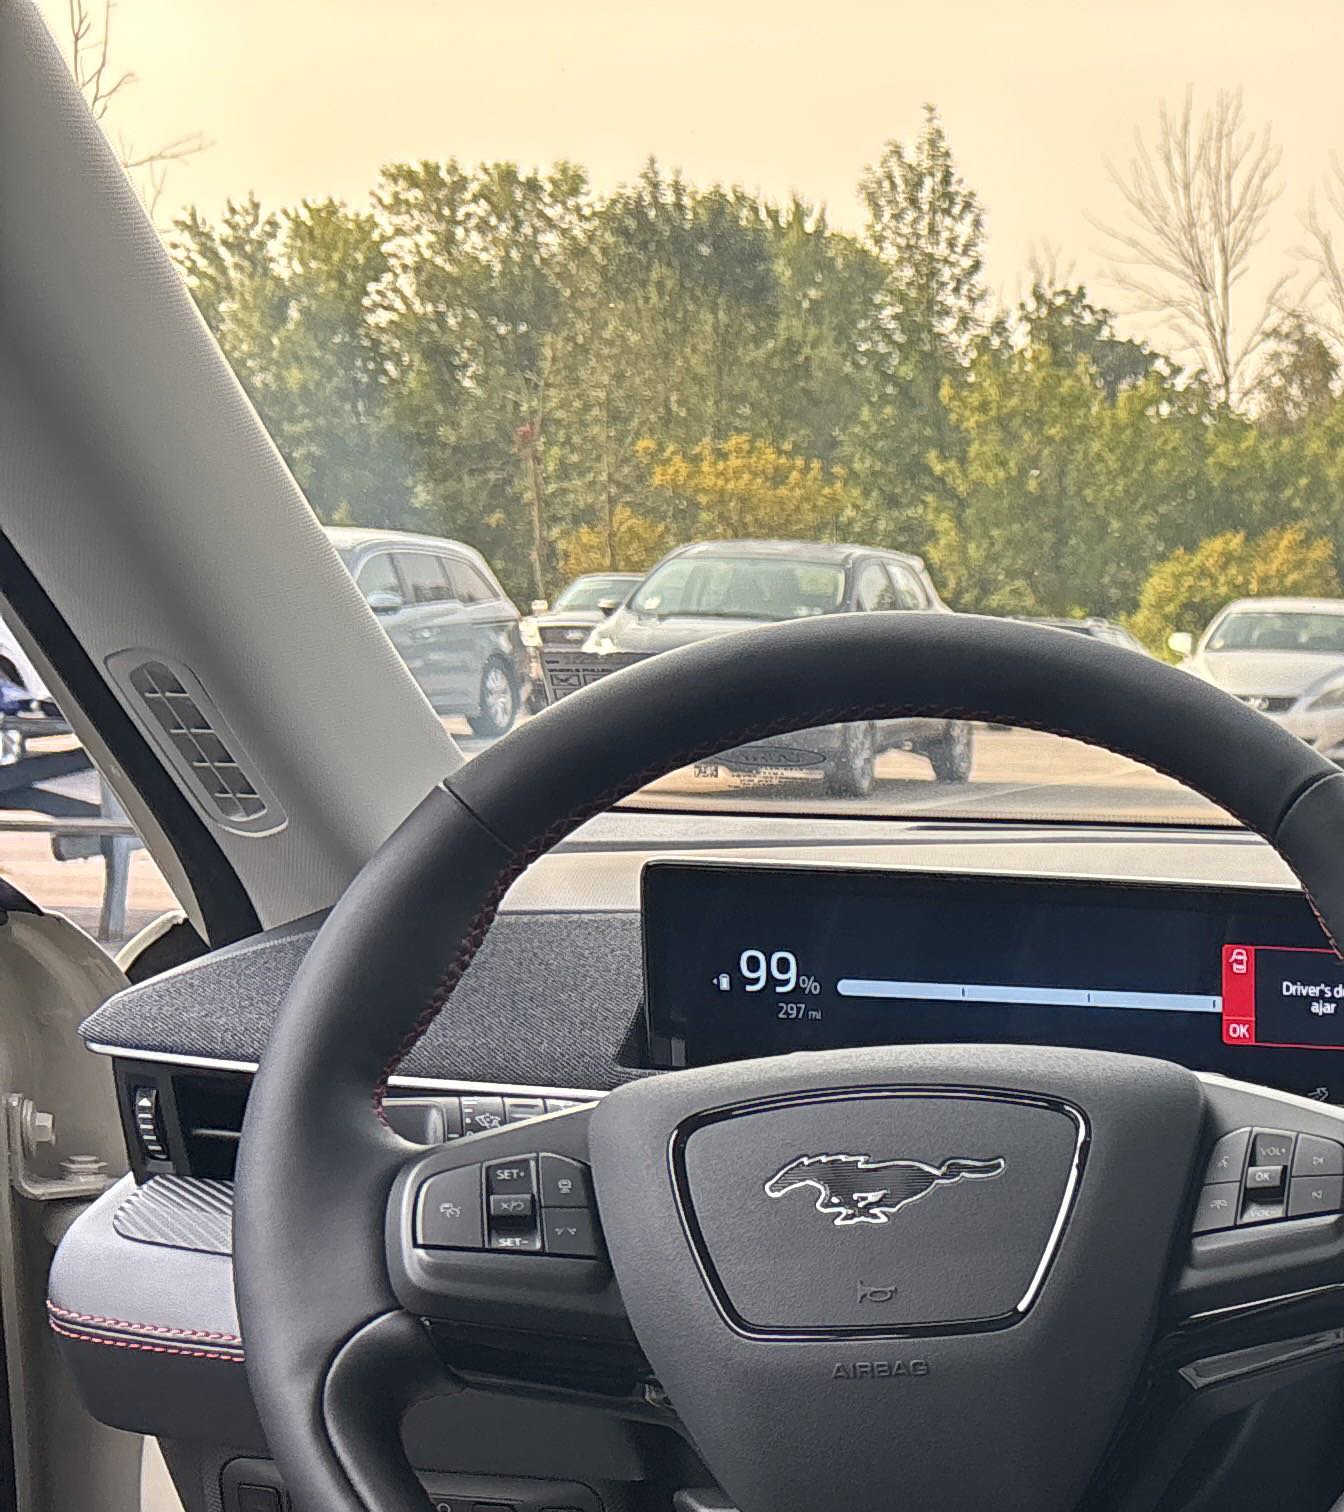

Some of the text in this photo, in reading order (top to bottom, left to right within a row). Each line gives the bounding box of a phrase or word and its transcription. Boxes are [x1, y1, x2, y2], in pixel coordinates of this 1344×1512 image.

[1282, 981, 1332, 998] Driver's
[778, 1002, 821, 1019] 297 mi
[1310, 1001, 1337, 1017] ajar
[1229, 1023, 1249, 1038] OK
[1255, 1172, 1271, 1181] OK
[832, 1360, 928, 1378] AIRBAG
